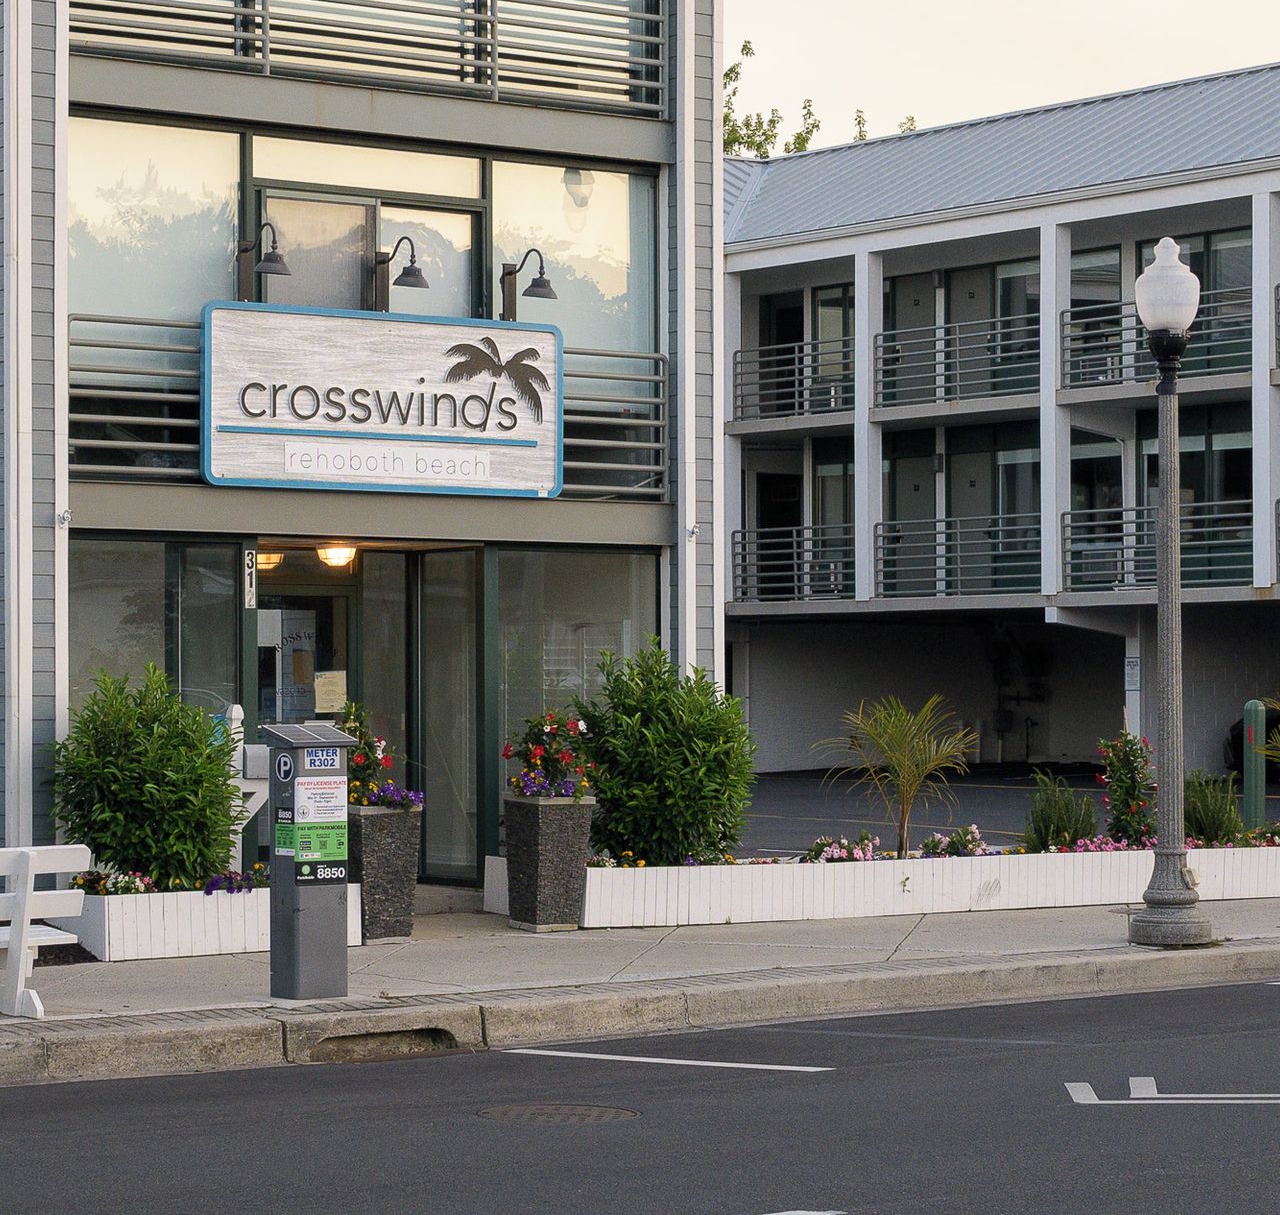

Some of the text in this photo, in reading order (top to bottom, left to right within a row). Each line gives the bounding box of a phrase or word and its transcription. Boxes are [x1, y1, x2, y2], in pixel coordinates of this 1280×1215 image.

[239, 377, 518, 432] crosswinds
[289, 448, 487, 476] rehoboth beach
[306, 748, 338, 758] METER
[309, 758, 336, 768] R302
[317, 867, 345, 879] 8850
